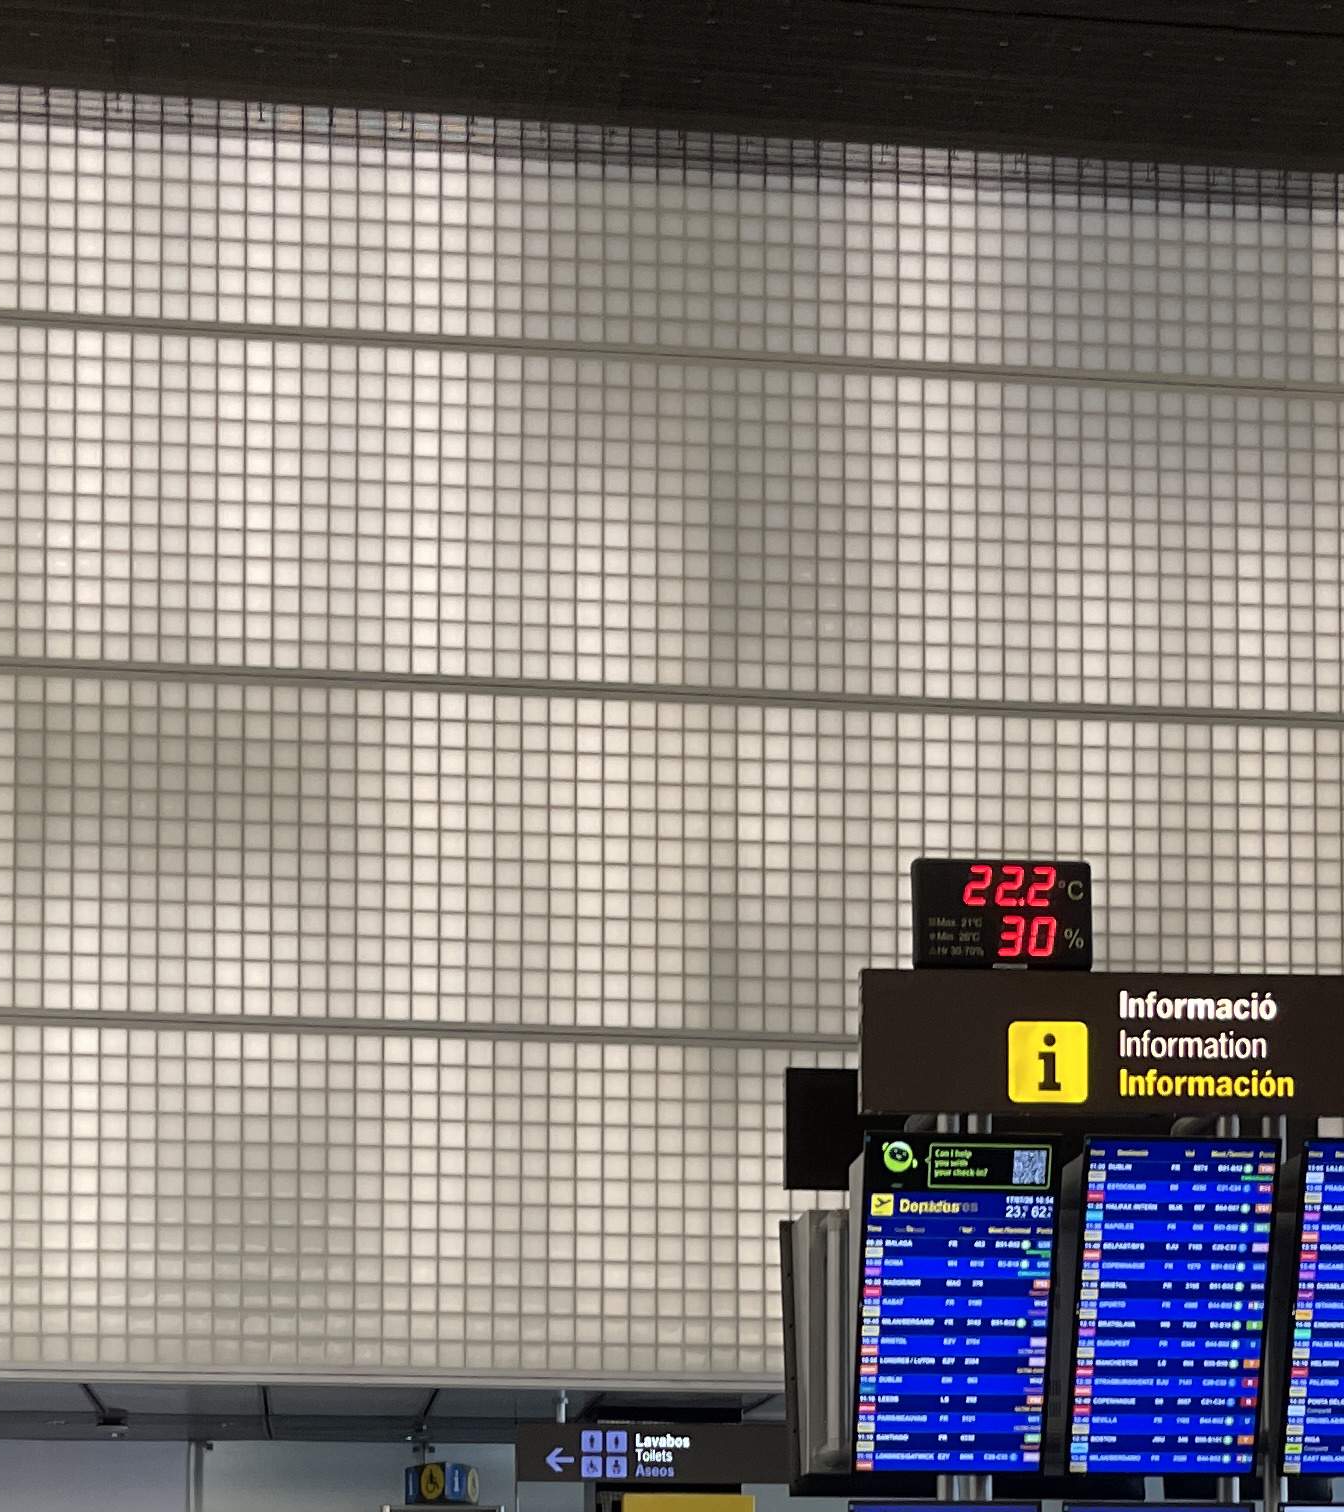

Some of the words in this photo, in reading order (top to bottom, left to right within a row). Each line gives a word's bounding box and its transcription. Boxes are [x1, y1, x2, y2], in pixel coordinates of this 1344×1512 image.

[998, 915, 1056, 957] 30
[1064, 928, 1084, 949] %
[1119, 990, 1277, 1020] Informació
[1119, 1029, 1267, 1059] Information
[1119, 1068, 1295, 1097] Información
[635, 1433, 691, 1448] Lavabos
[635, 1449, 673, 1462] Toilets
[635, 1464, 674, 1478] Aseos
